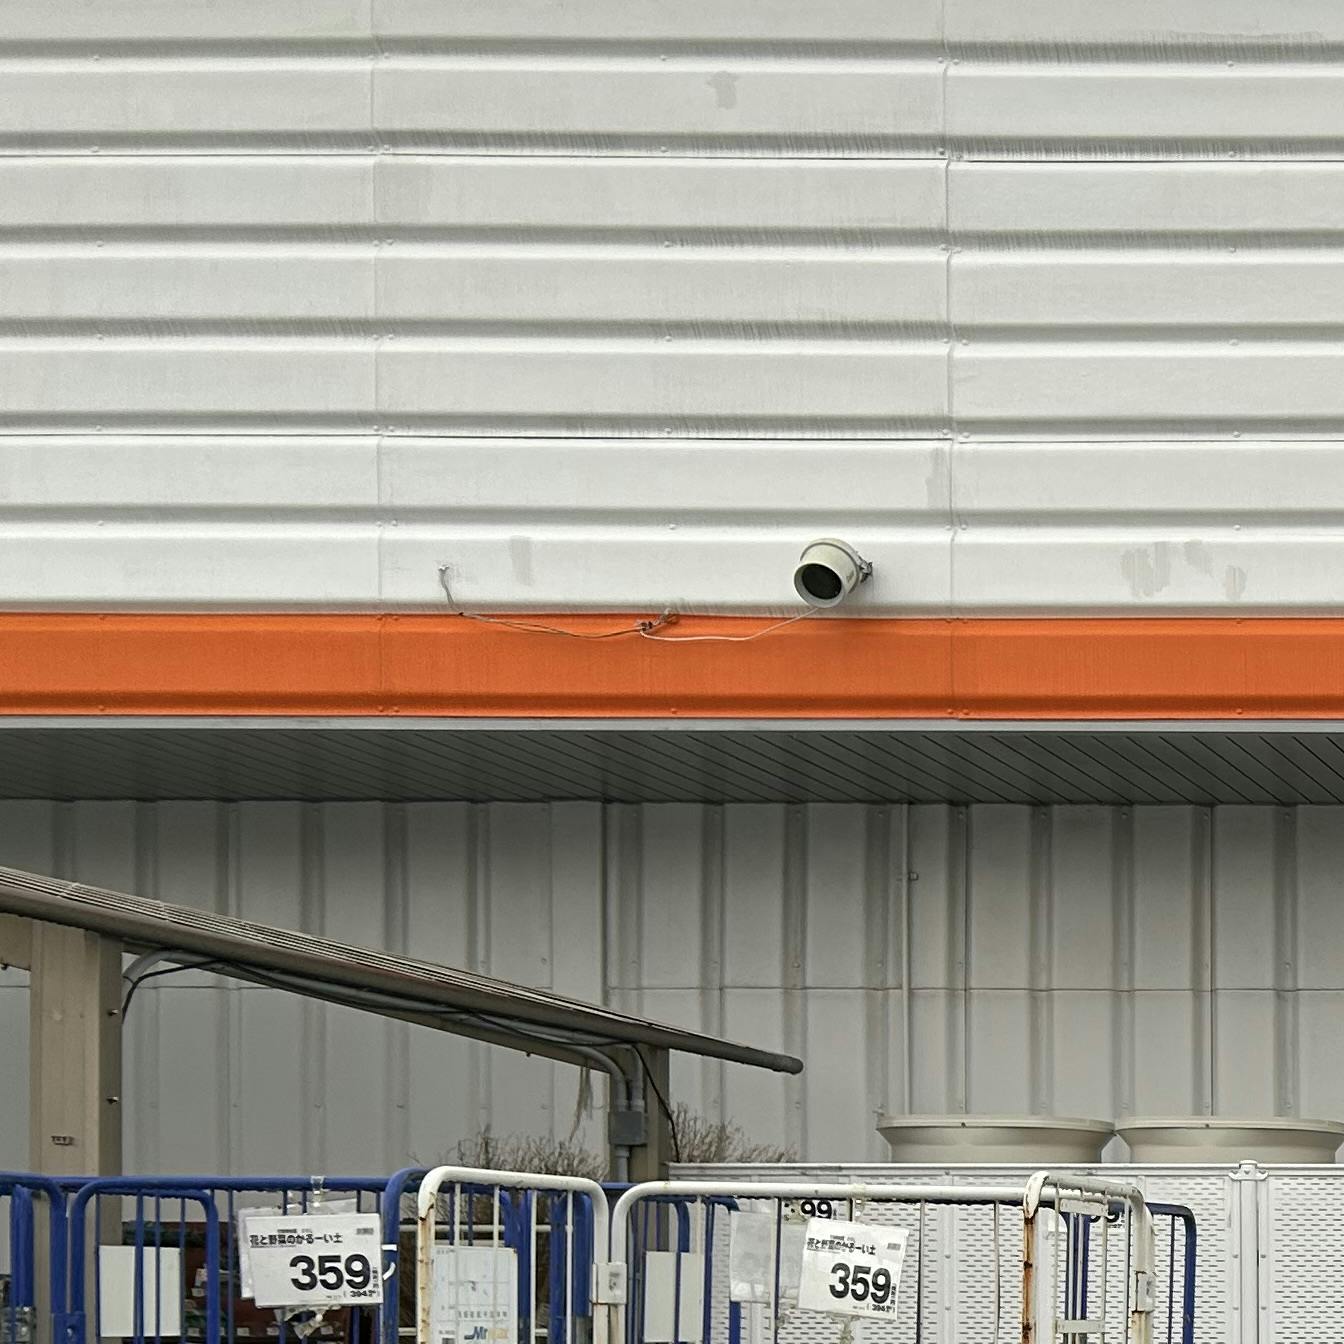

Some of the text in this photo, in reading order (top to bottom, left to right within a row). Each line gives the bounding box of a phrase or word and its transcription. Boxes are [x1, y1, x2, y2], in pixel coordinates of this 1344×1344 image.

[250, 1233, 343, 1245] 花と野菜のかるーい土
[289, 1254, 371, 1290] 359
[829, 1263, 891, 1304] 359
